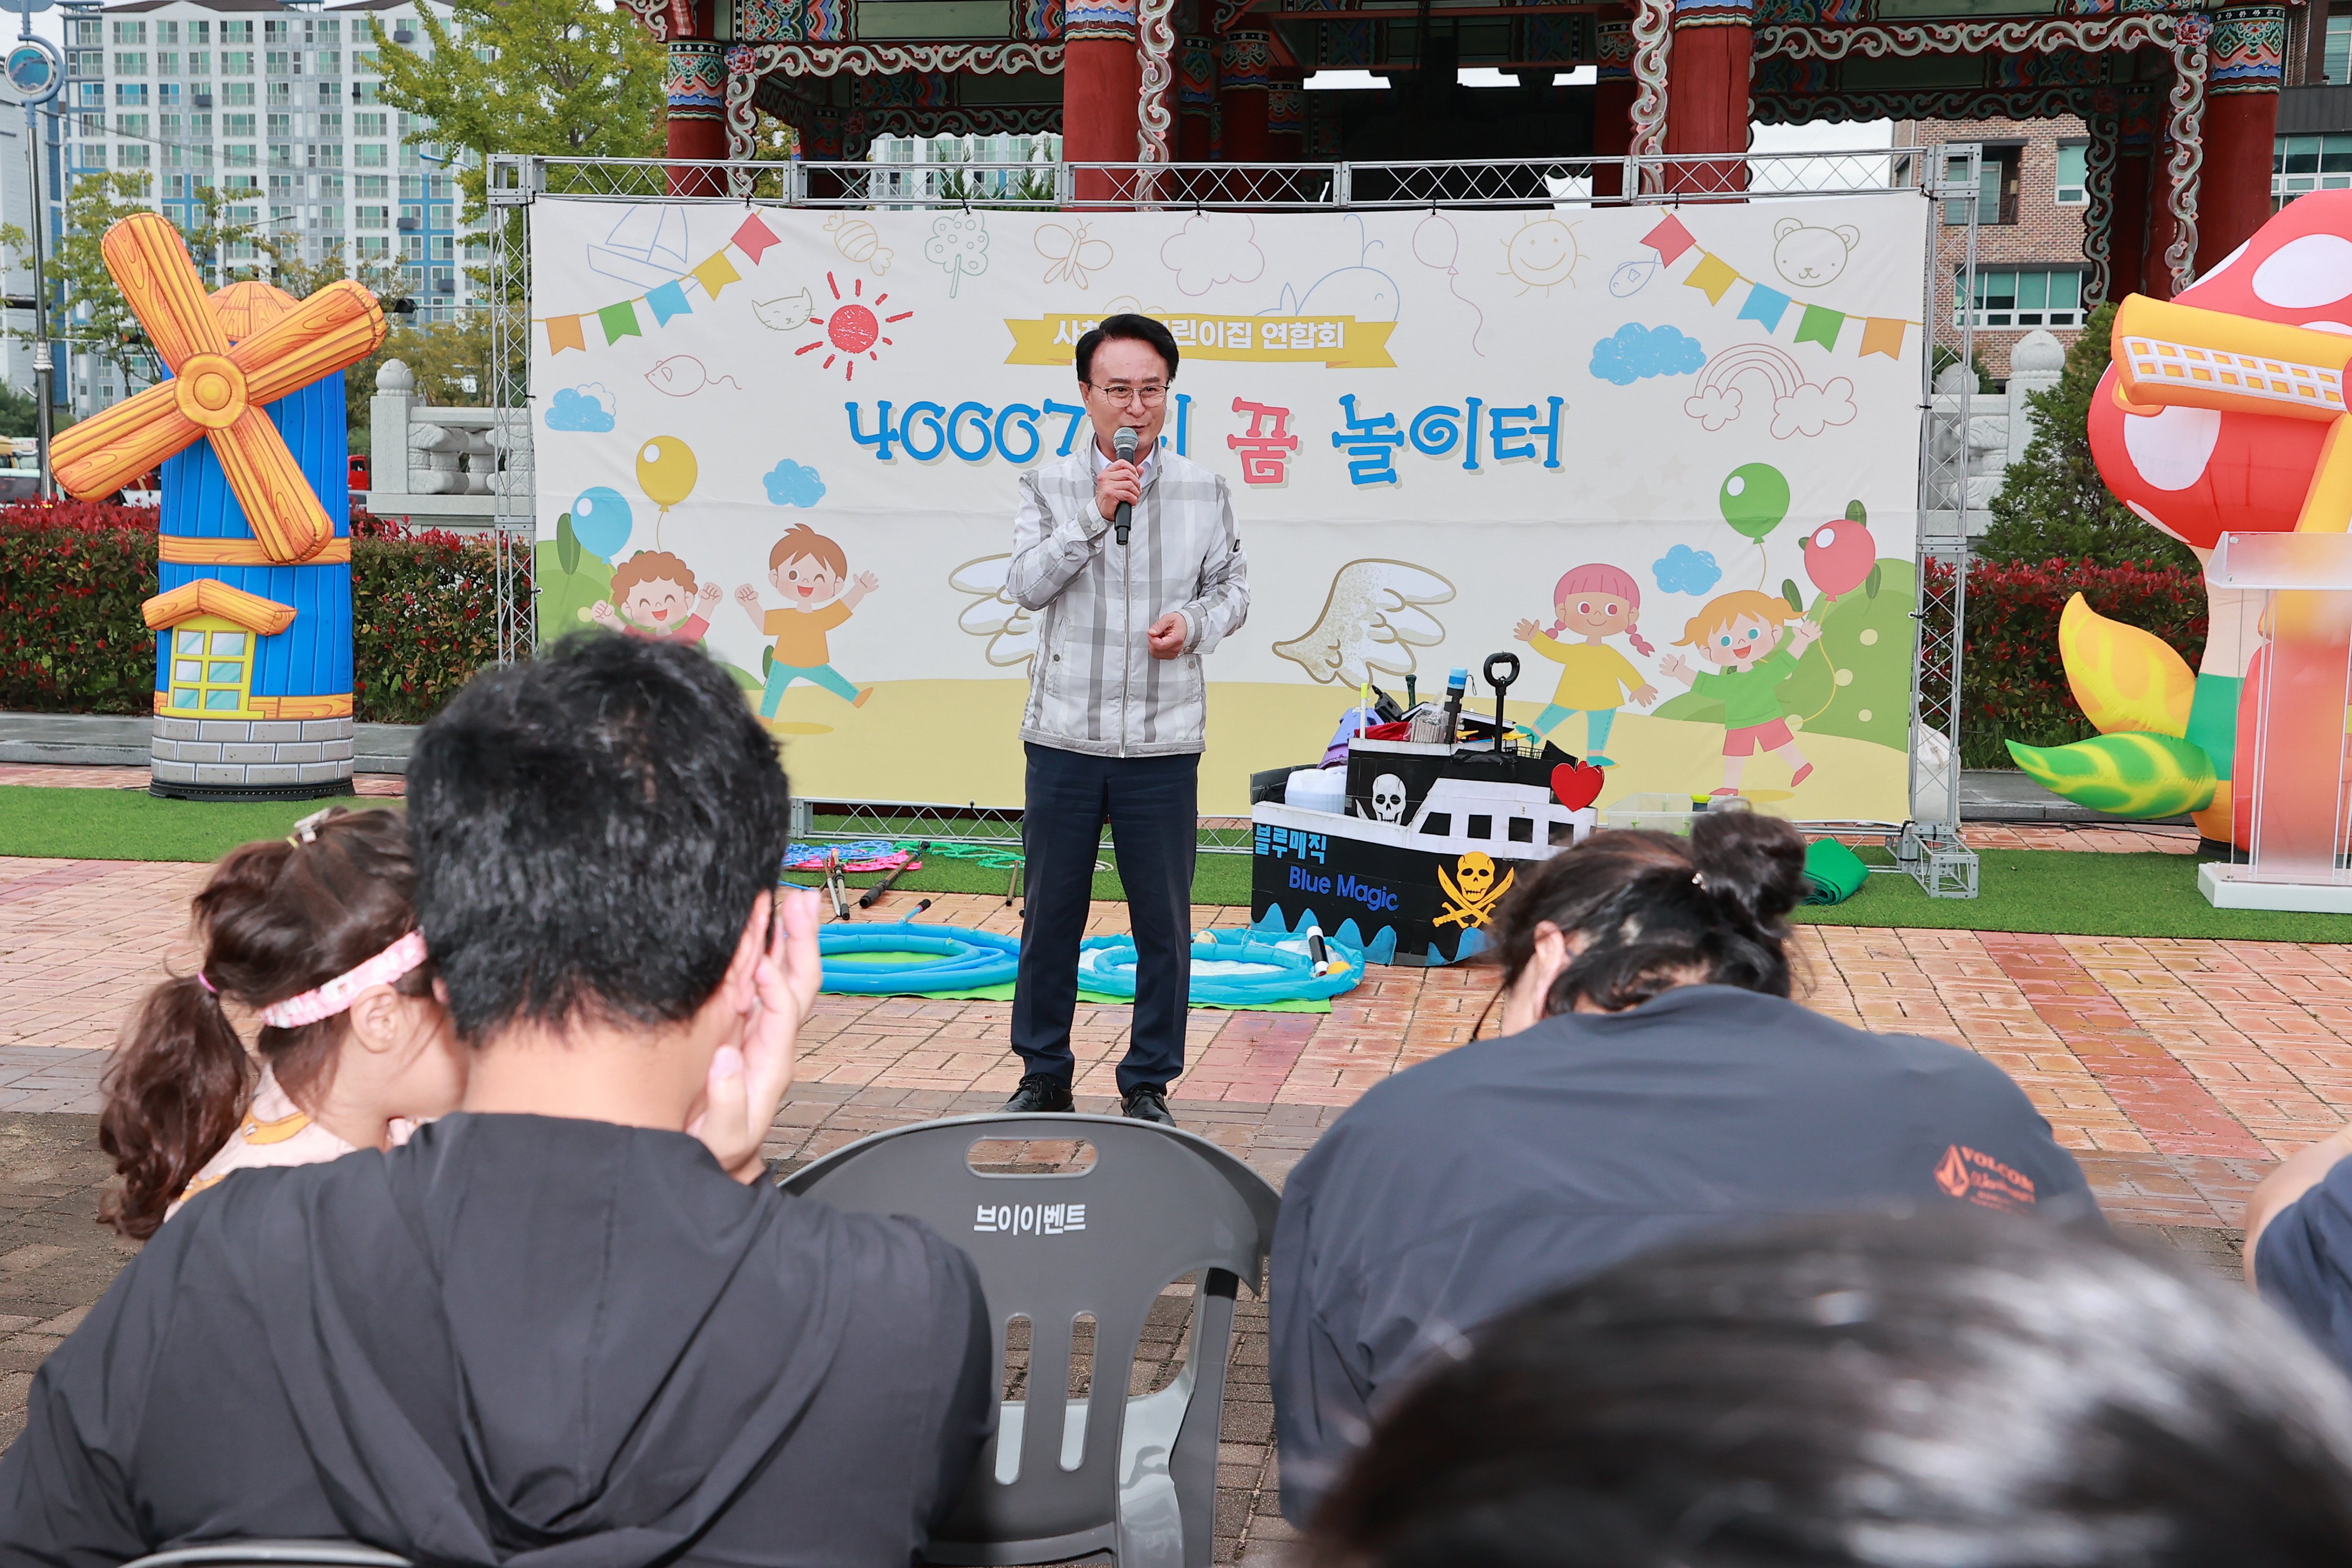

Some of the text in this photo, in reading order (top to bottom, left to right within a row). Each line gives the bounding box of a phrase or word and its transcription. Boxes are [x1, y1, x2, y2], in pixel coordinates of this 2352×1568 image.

[1163, 319, 1252, 349] 린이집
[1261, 320, 1345, 349] 연합회
[1227, 396, 1298, 484] 꿈
[1332, 393, 1564, 485] 놀이터
[1254, 824, 1328, 864] 블루매직
[1288, 866, 1400, 911] Blue Magic
[973, 1203, 1086, 1236] 브이이벤트
